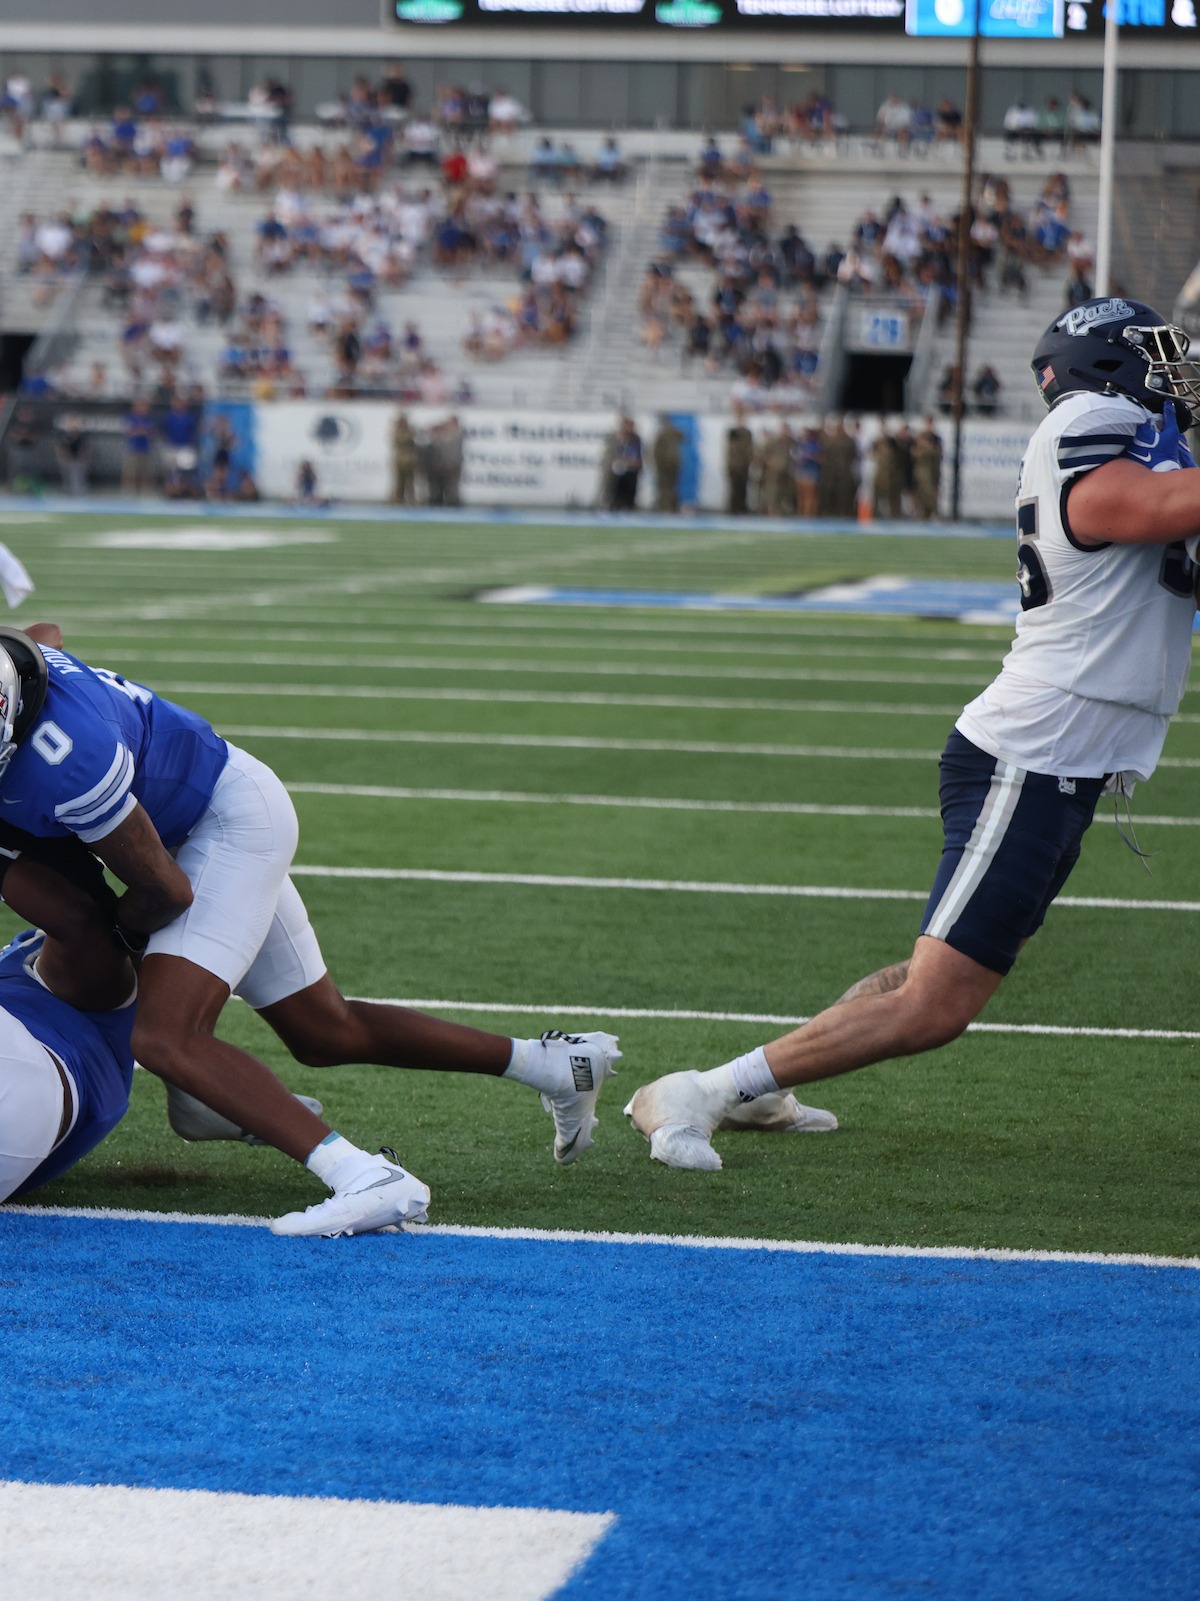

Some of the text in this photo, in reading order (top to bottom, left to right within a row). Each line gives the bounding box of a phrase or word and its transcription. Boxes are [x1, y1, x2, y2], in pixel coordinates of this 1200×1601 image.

[1056, 297, 1136, 337] Pack
[31, 720, 73, 765] 0
[569, 1055, 594, 1092] NIKE
